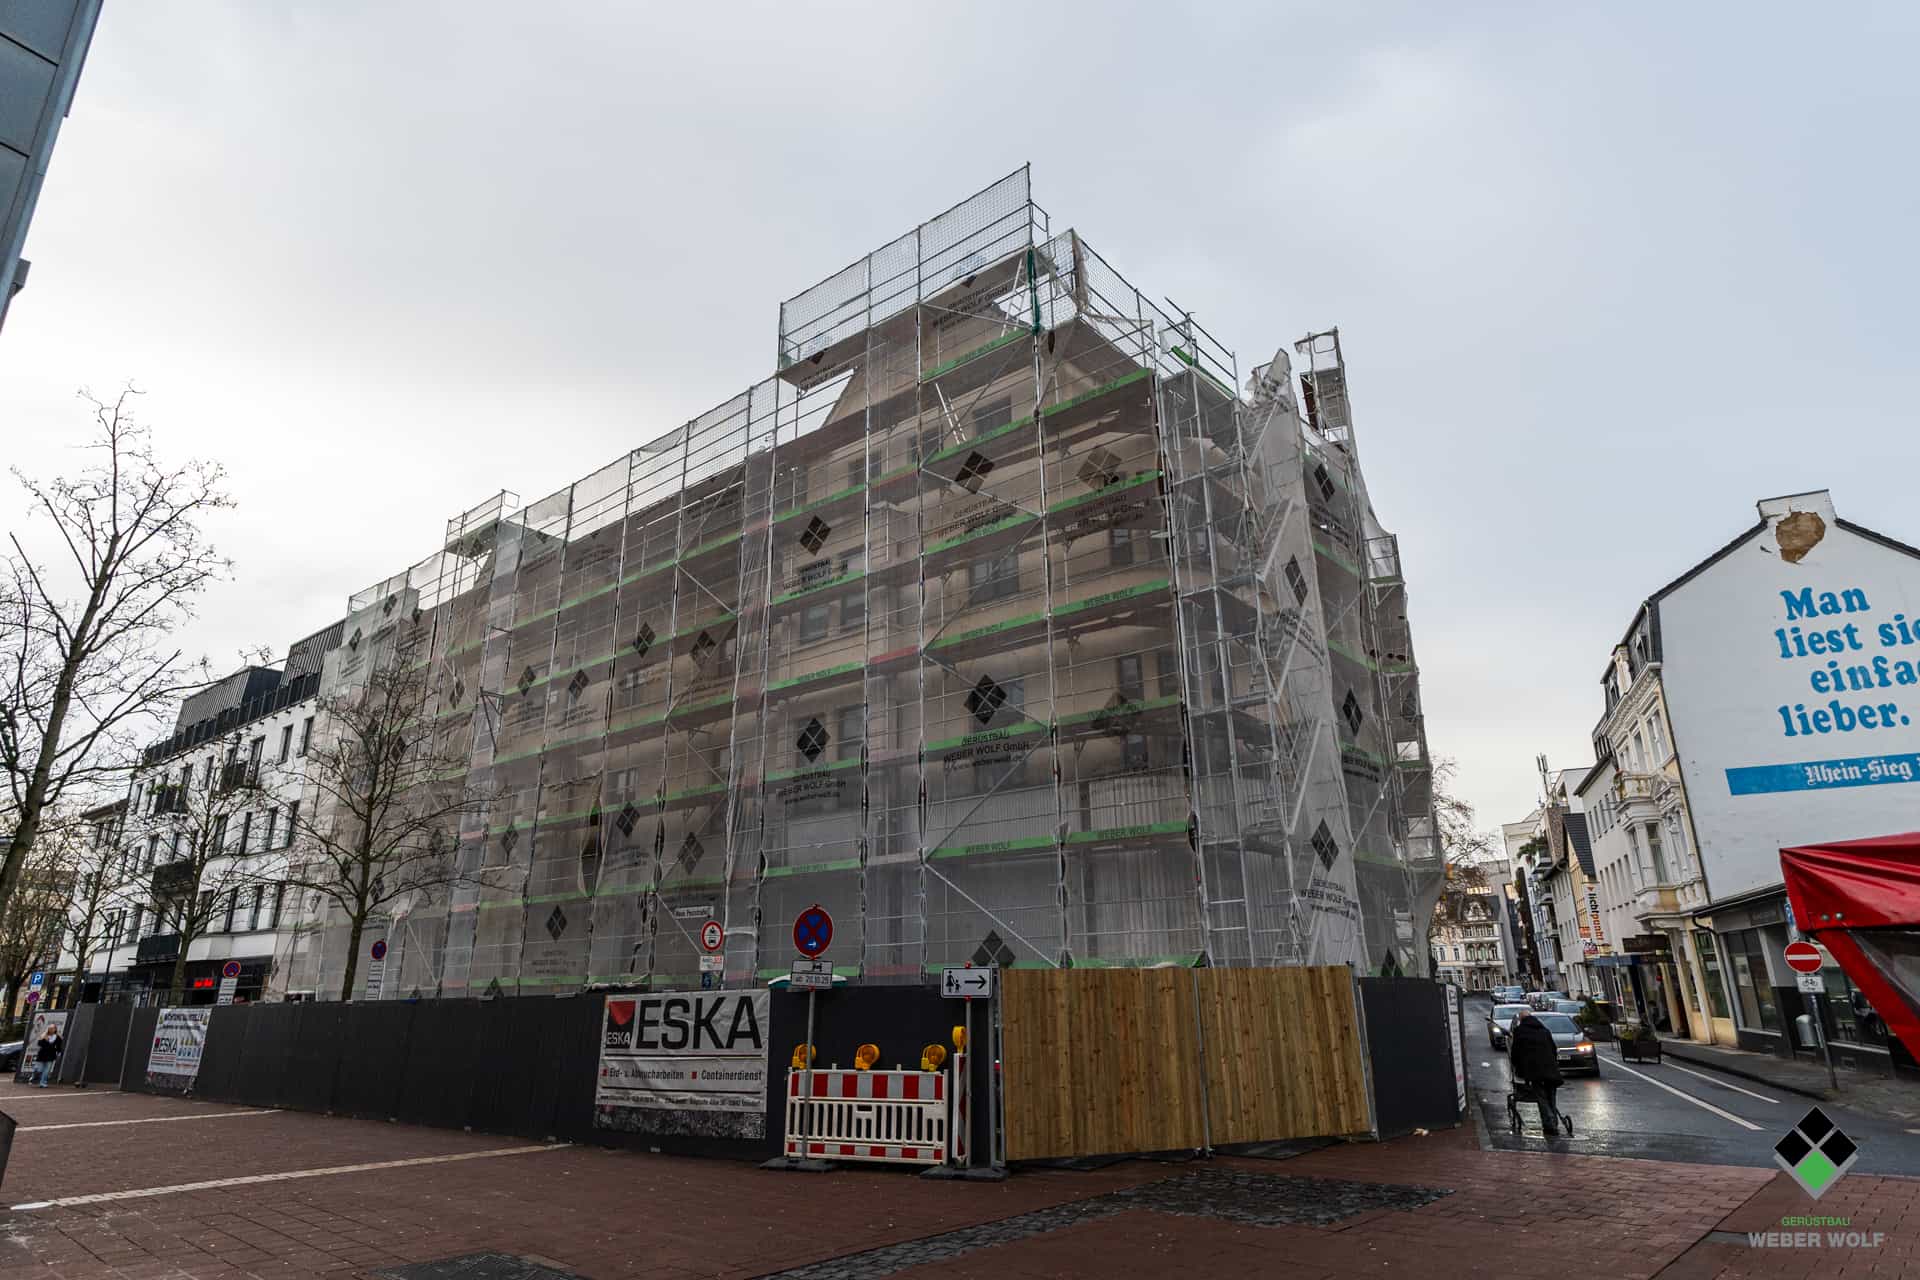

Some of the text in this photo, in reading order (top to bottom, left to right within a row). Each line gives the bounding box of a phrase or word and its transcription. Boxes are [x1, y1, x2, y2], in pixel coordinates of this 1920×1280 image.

[1780, 587, 1870, 621] Man
[1774, 622, 1863, 659] liest
[1810, 655, 1920, 694] einfa
[1777, 699, 1910, 736] lieber.
[1804, 760, 1913, 785] Rhein-Sieg
[607, 1032, 631, 1046] ESKA
[636, 996, 762, 1049] ESKA
[701, 1069, 762, 1081] Containerdienst
